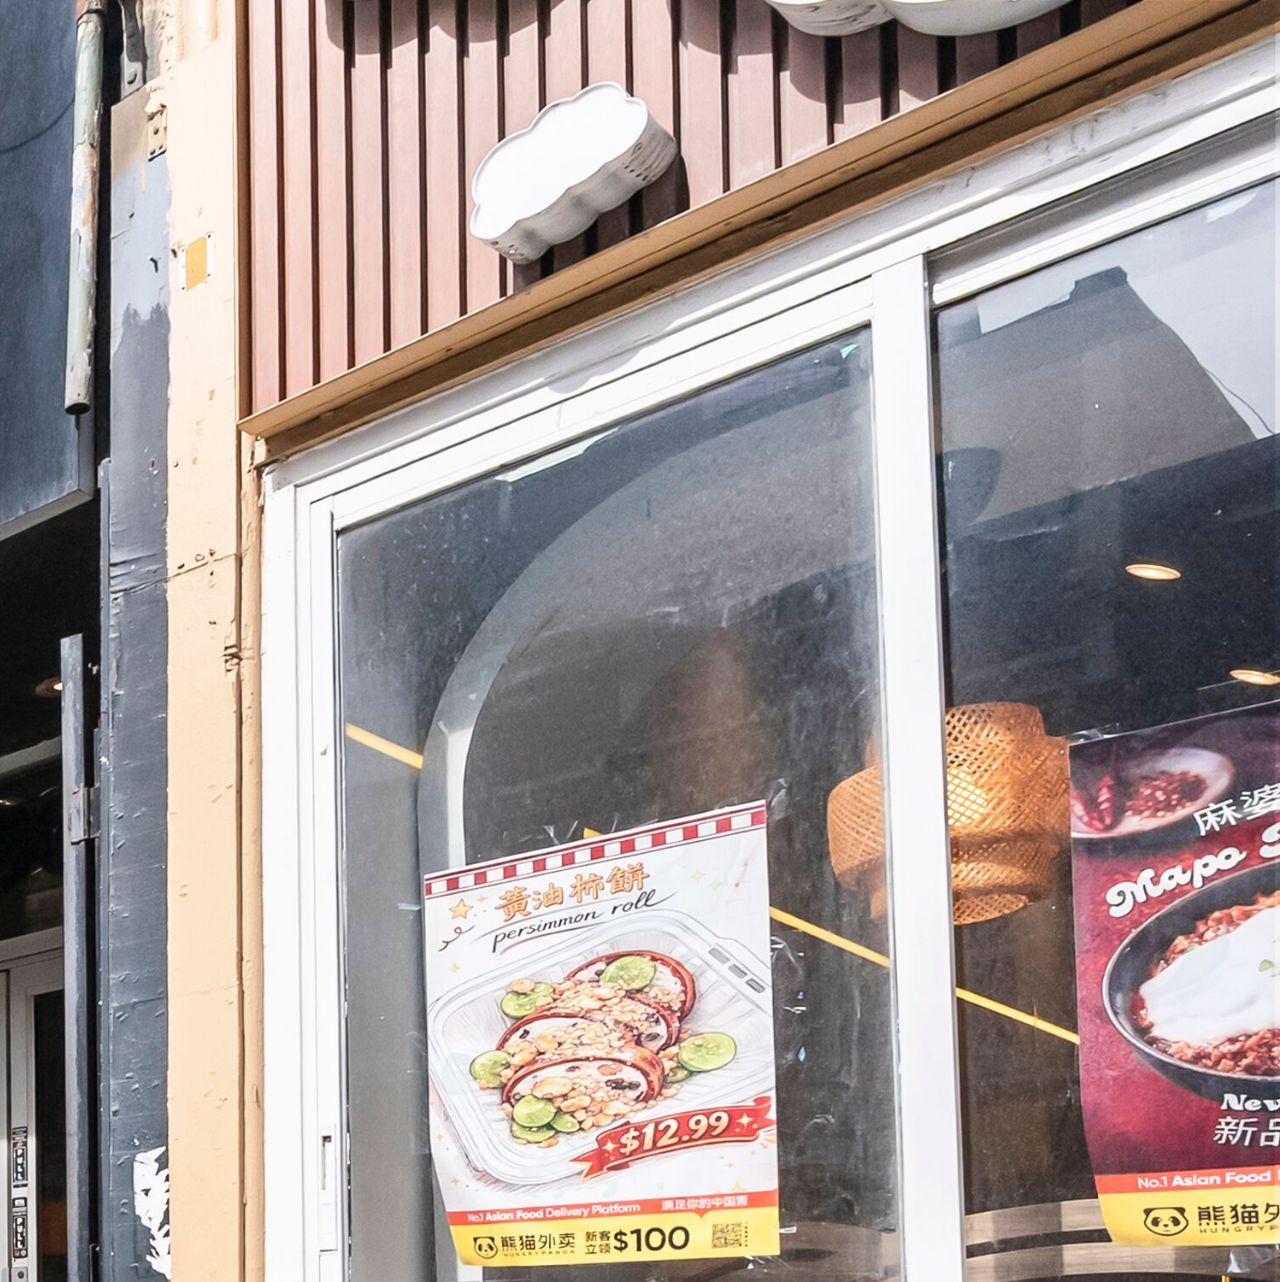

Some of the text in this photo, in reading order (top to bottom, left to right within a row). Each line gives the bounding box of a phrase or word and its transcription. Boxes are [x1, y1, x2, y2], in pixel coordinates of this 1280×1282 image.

[1105, 847, 1247, 918] Mapo
[492, 888, 662, 953] persimmon roll
[619, 1110, 730, 1157] $12.99
[1137, 1176, 1168, 1189] No.1
[1172, 1174, 1220, 1187] Asian
[1225, 1170, 1271, 1184] Food
[485, 1210, 515, 1222] Asian
[516, 1209, 545, 1220] Food
[546, 1206, 589, 1219] Delivery
[591, 1203, 641, 1216] Platform
[500, 1232, 576, 1252] 熊猫外卖
[585, 1230, 611, 1243] 新客
[613, 1225, 690, 1253] $100
[584, 1243, 611, 1255] 立领
